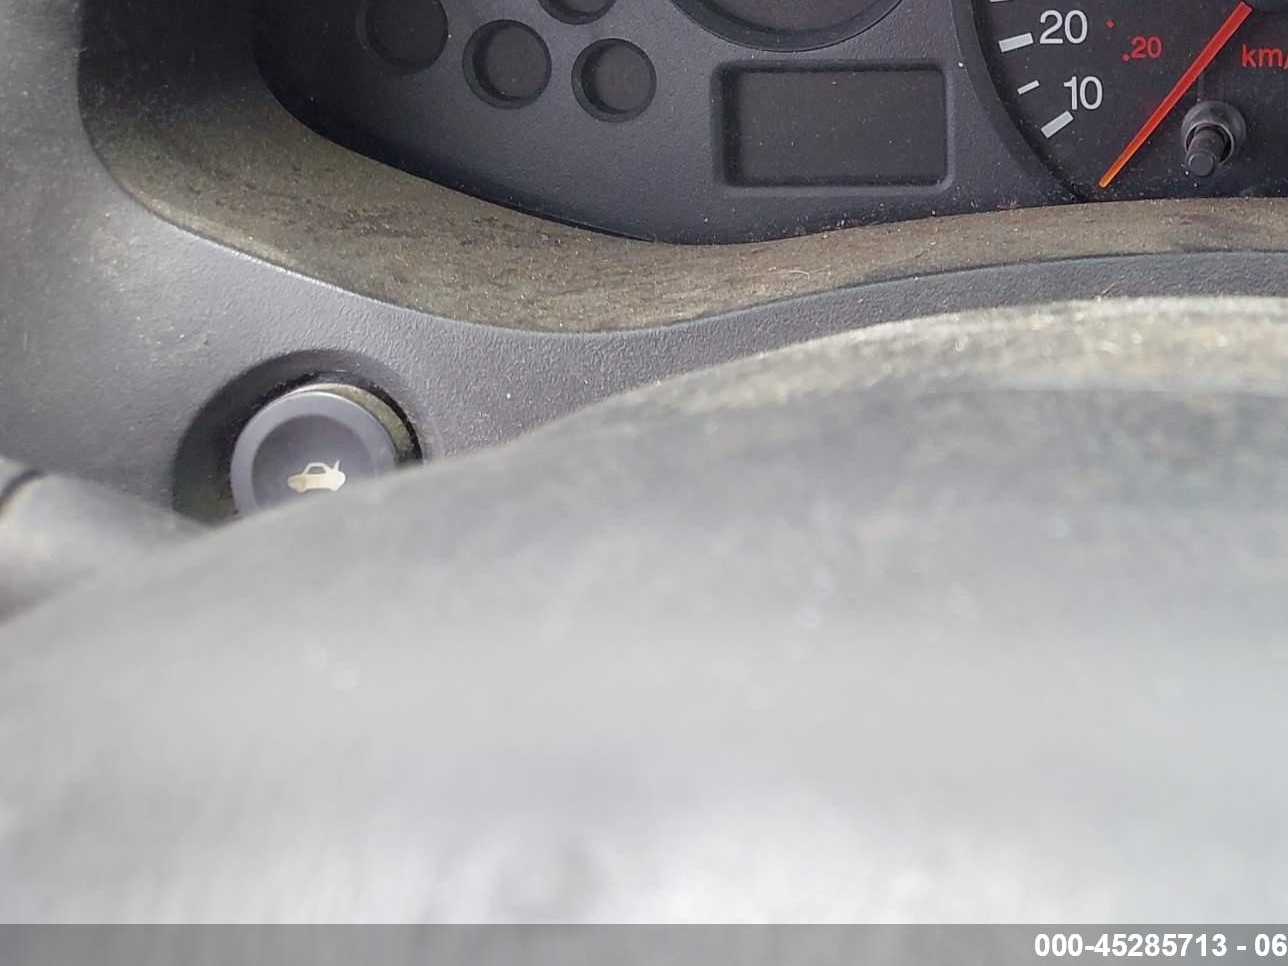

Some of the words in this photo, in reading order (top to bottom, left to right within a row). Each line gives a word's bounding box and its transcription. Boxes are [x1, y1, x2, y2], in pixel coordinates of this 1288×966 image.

[1039, 9, 1089, 45] 20
[1131, 36, 1163, 59] 20
[1063, 75, 1103, 110] 10
